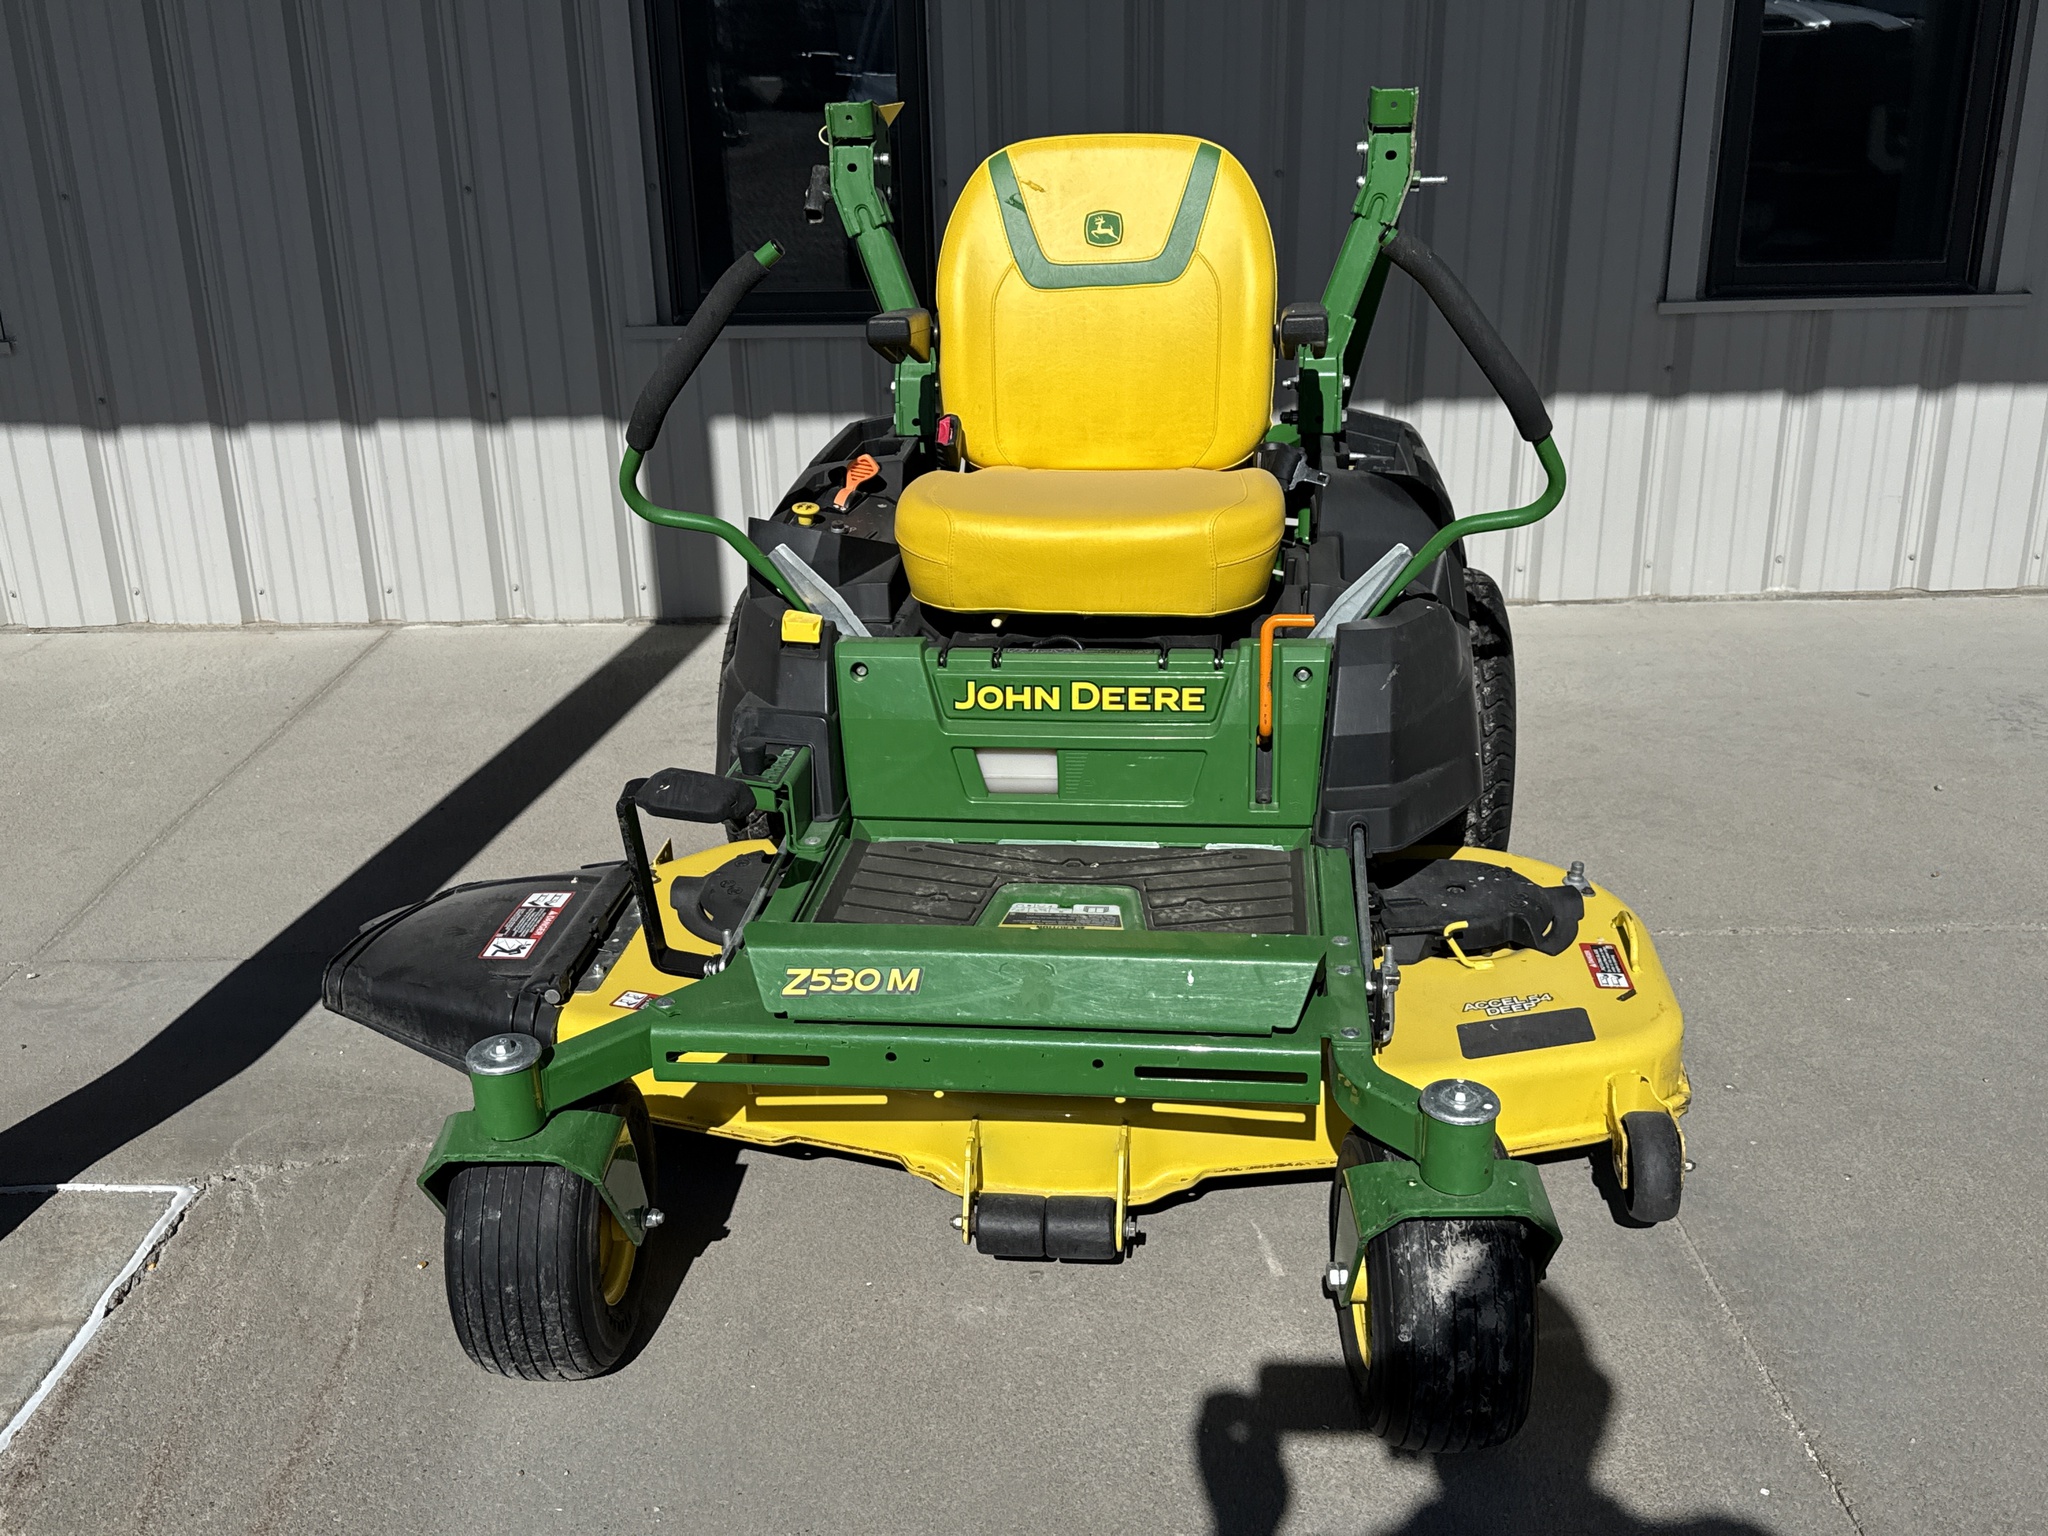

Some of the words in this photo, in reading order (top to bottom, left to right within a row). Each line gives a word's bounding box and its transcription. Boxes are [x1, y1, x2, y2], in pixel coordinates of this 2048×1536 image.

[954, 680, 1060, 711] JOHN
[1070, 681, 1206, 712] DEERE
[781, 967, 882, 997] Z530
[886, 967, 922, 993] M
[1463, 996, 1526, 1012] ACCEL
[1486, 1002, 1537, 1016] DEEP
